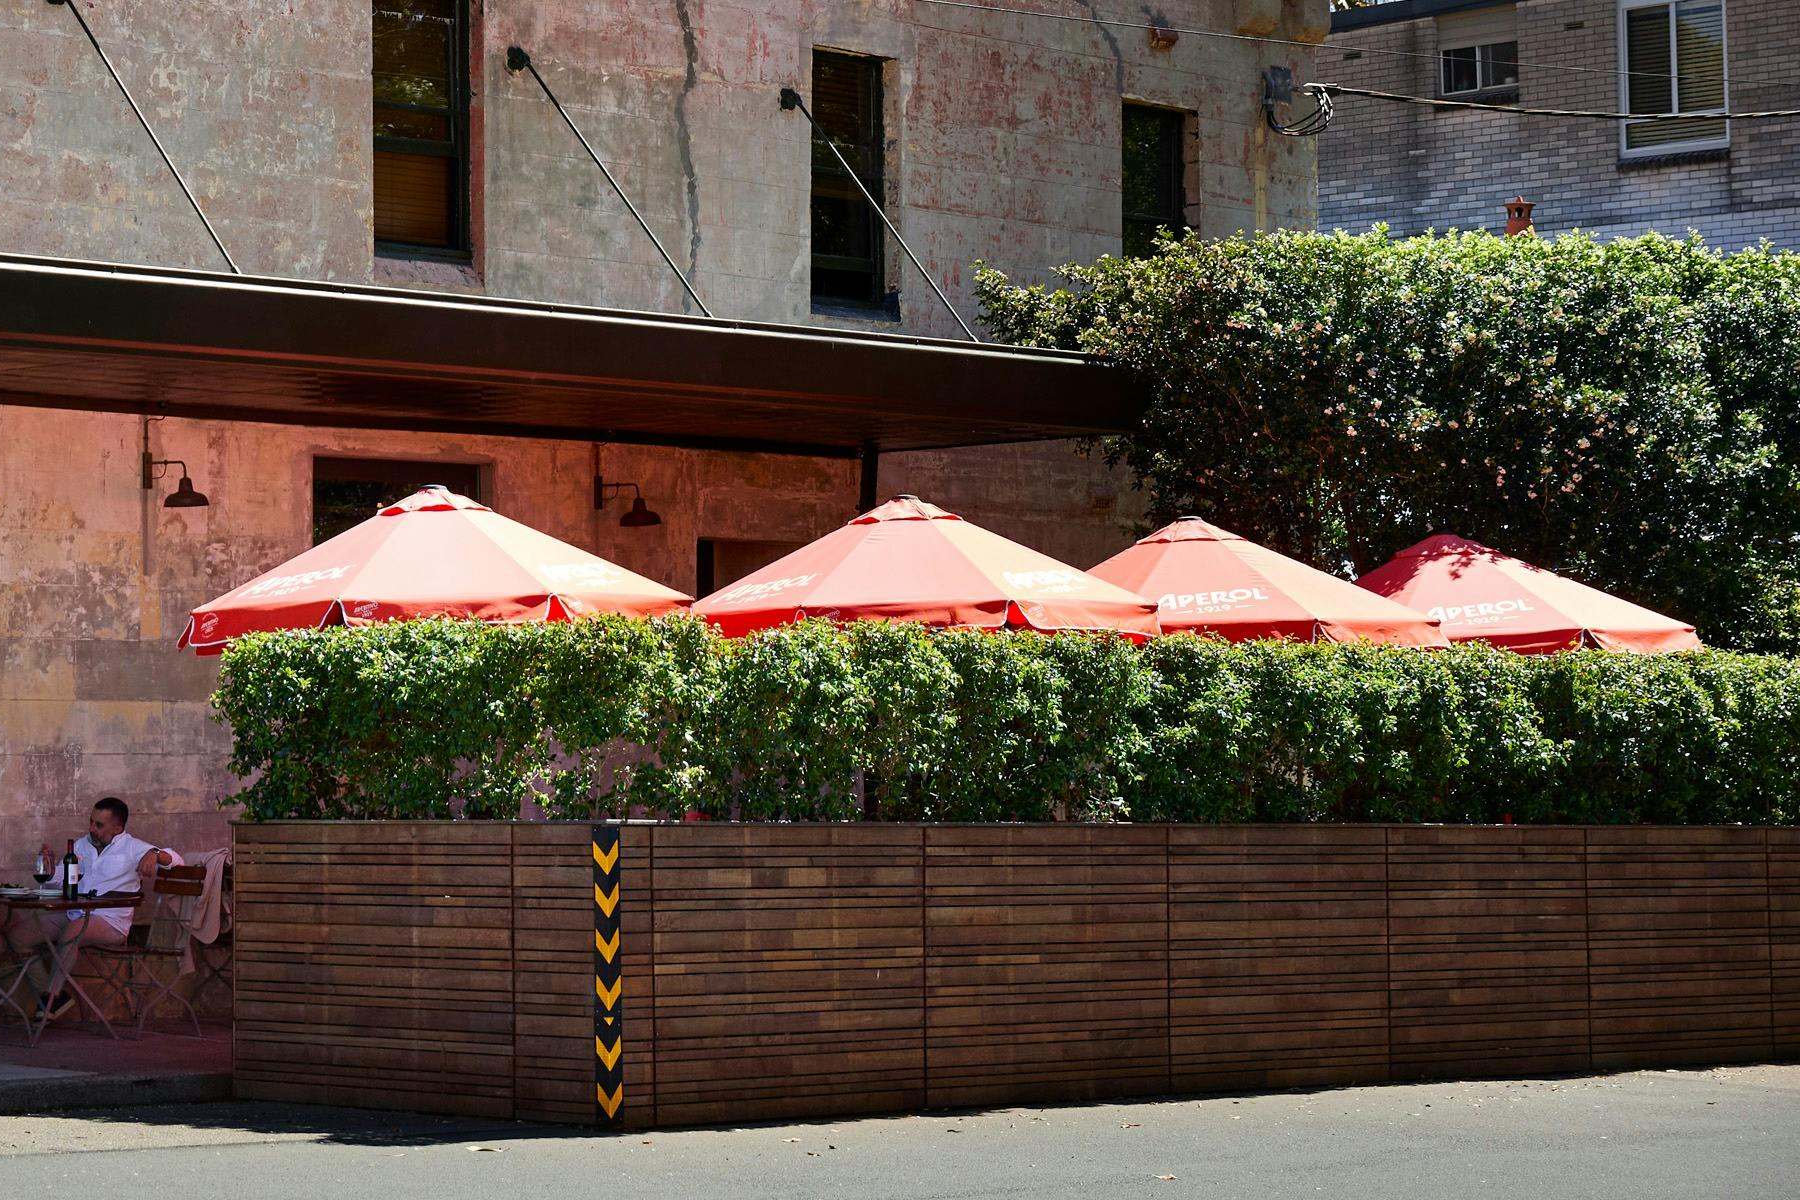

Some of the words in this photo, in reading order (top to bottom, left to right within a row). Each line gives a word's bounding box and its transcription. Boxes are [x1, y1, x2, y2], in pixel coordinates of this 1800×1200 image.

[1157, 587, 1269, 610] APEROL
[1196, 603, 1232, 614] 1919
[1426, 599, 1535, 622] APEROL
[1465, 615, 1500, 625] 1919
